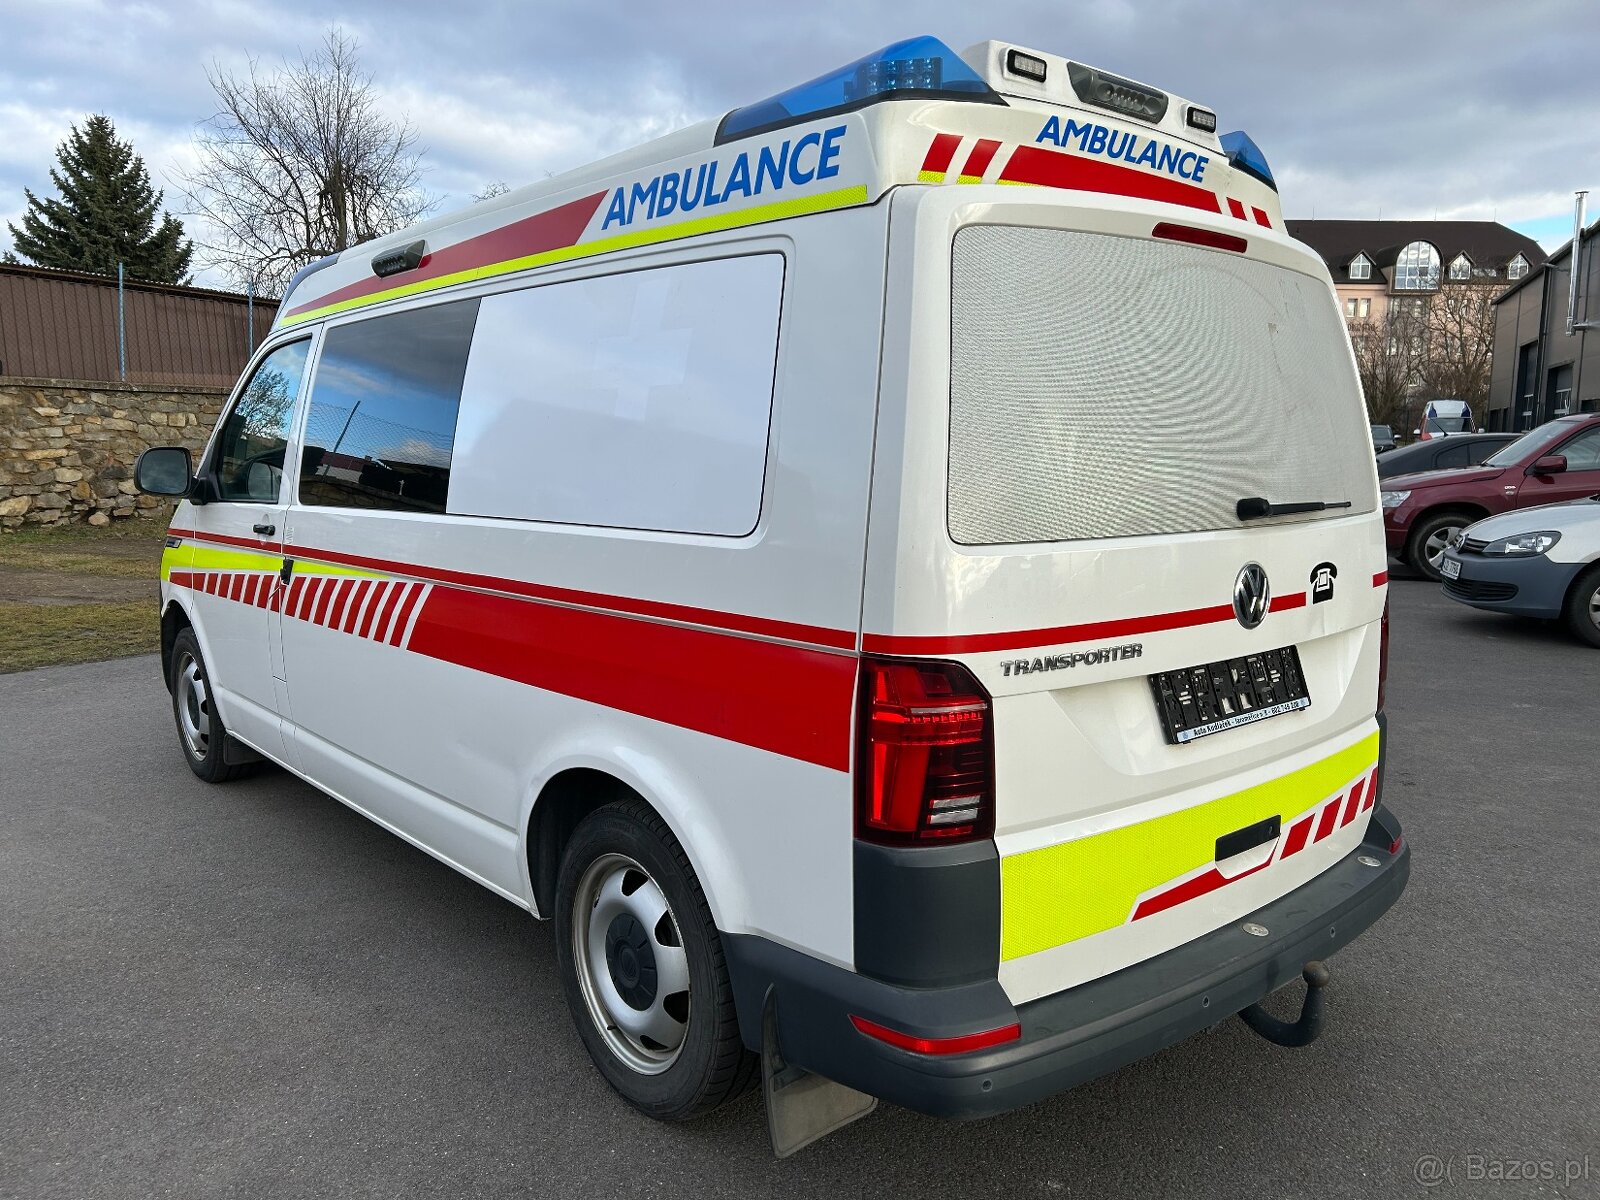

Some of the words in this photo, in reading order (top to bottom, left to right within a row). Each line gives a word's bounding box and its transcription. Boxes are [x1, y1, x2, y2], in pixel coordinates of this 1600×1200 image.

[1036, 115, 1209, 183] AMBULANCE
[601, 124, 848, 231] AMBULANCE
[1000, 643, 1143, 677] TRANSPORTER
[1193, 727, 1207, 737] Auto
